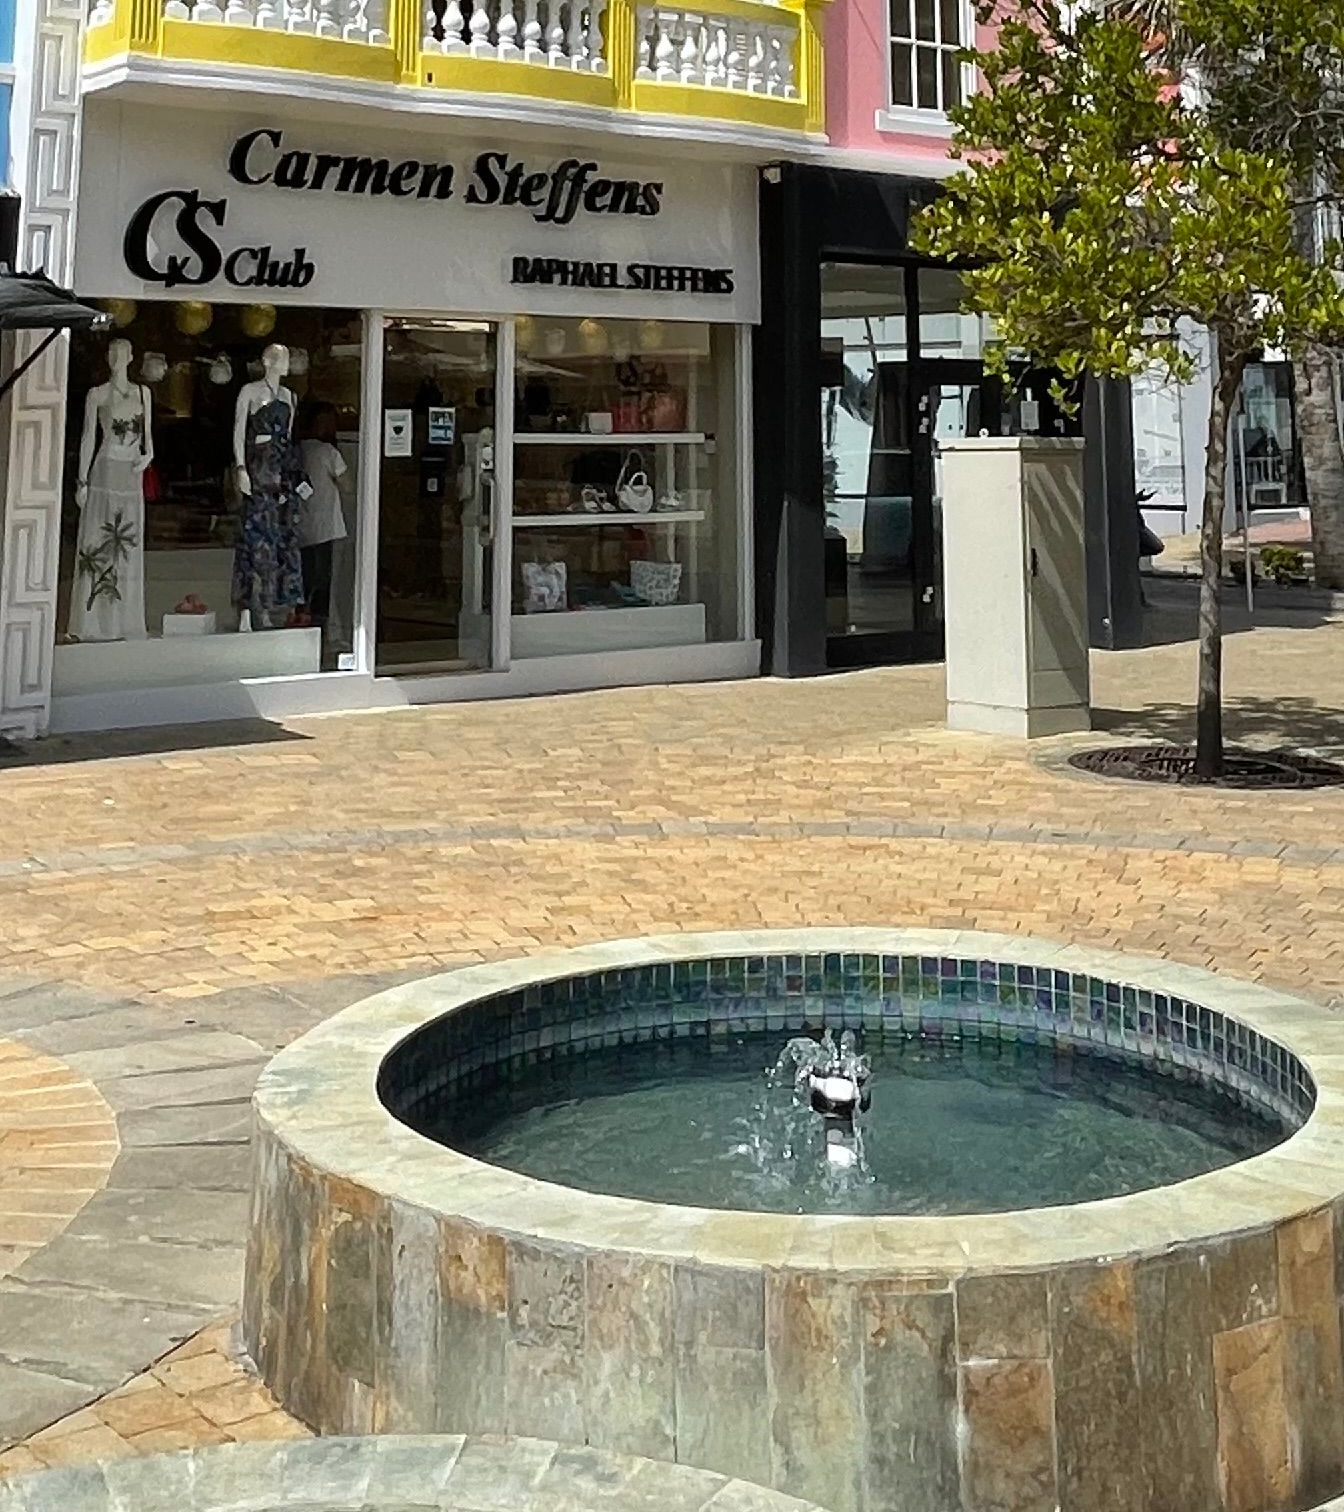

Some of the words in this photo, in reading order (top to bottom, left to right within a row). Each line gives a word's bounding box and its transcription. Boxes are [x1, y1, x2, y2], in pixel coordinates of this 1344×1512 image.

[228, 128, 454, 200] Carmen
[463, 152, 664, 224] Steffens
[123, 189, 227, 288] CS
[224, 246, 316, 288] Club
[510, 256, 625, 289] RAPHAEL
[625, 263, 735, 295] STEFFENS
